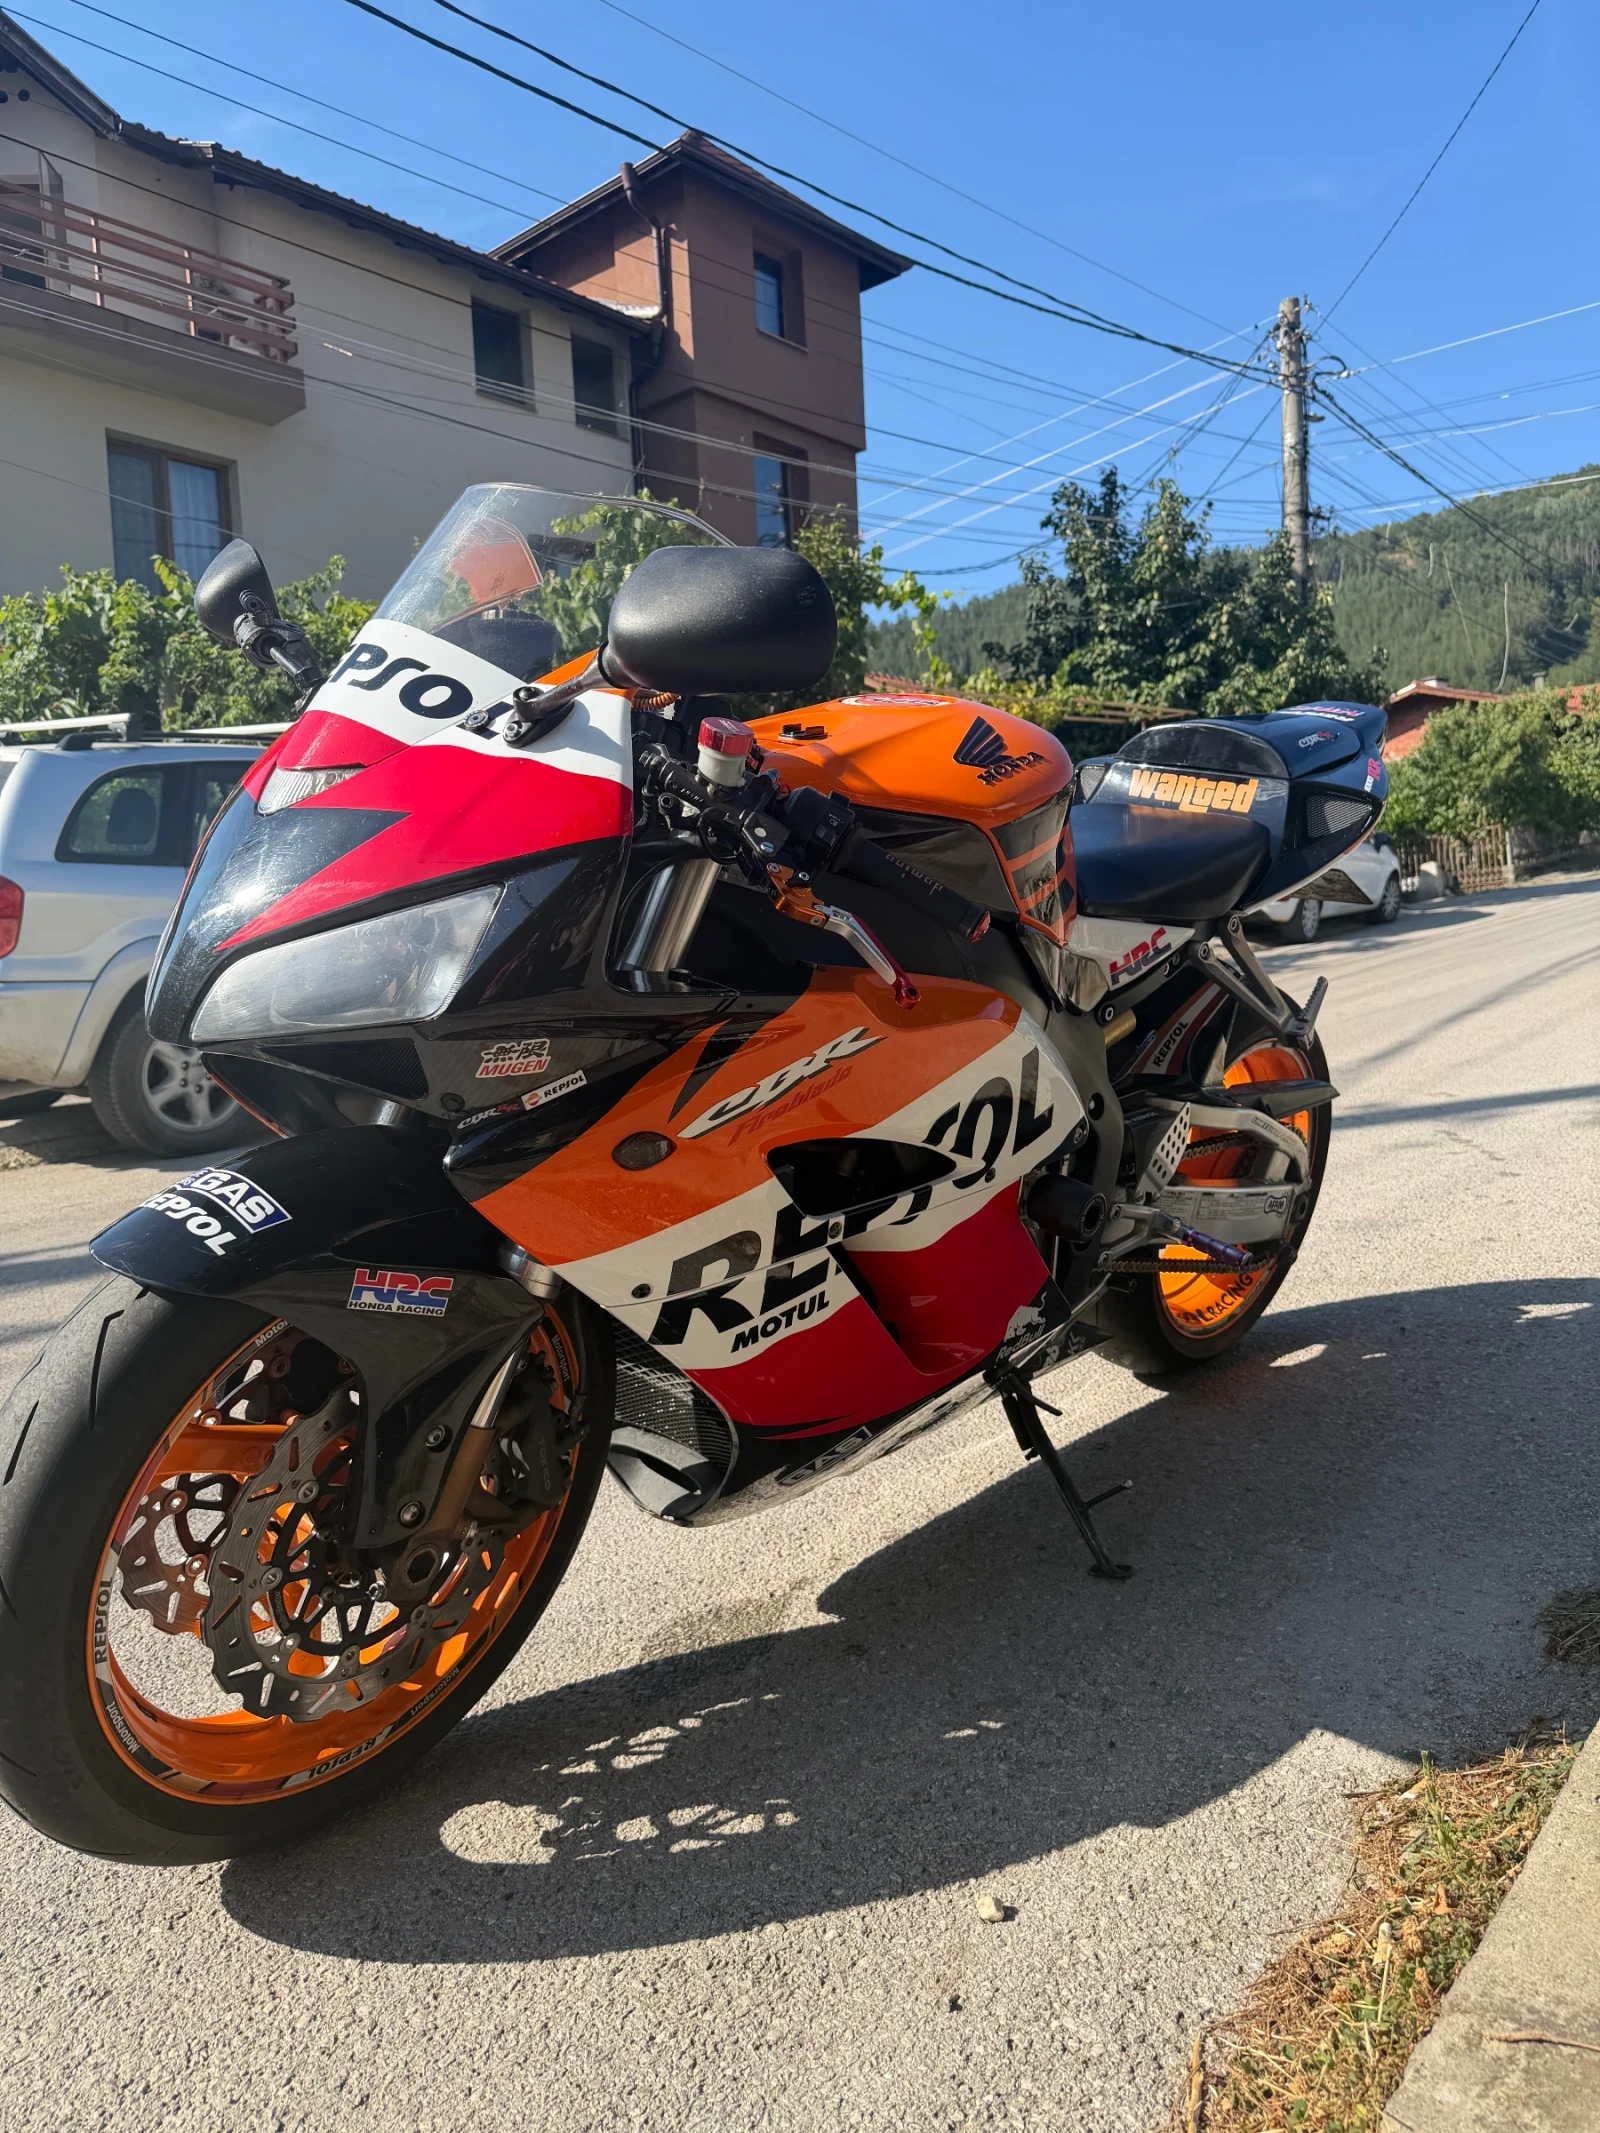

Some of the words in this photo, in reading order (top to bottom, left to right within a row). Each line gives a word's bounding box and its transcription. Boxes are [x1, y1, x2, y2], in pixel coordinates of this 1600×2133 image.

[976, 751, 1046, 787] HONDA
[1109, 926, 1172, 986] HRC
[478, 1058, 549, 1076] MUGEN
[1152, 1020, 1189, 1068] REPSOL
[543, 1074, 584, 1098] REPSOL
[676, 1025, 889, 1140] CBR
[727, 1064, 853, 1147] Fireblade
[190, 1172, 275, 1224] GAS
[142, 1192, 238, 1256] EPSOL
[348, 1300, 393, 1312] HONDA
[395, 1304, 444, 1316] RACING
[350, 1268, 454, 1309] HRC
[730, 1289, 830, 1353] MOTUL
[551, 1333, 571, 1383] Motorsport
[94, 1576, 113, 1665] REPSOL
[410, 1667, 460, 1717] Motorsport
[105, 1700, 140, 1754] Motorsport
[308, 1736, 377, 1779] REPSOL
